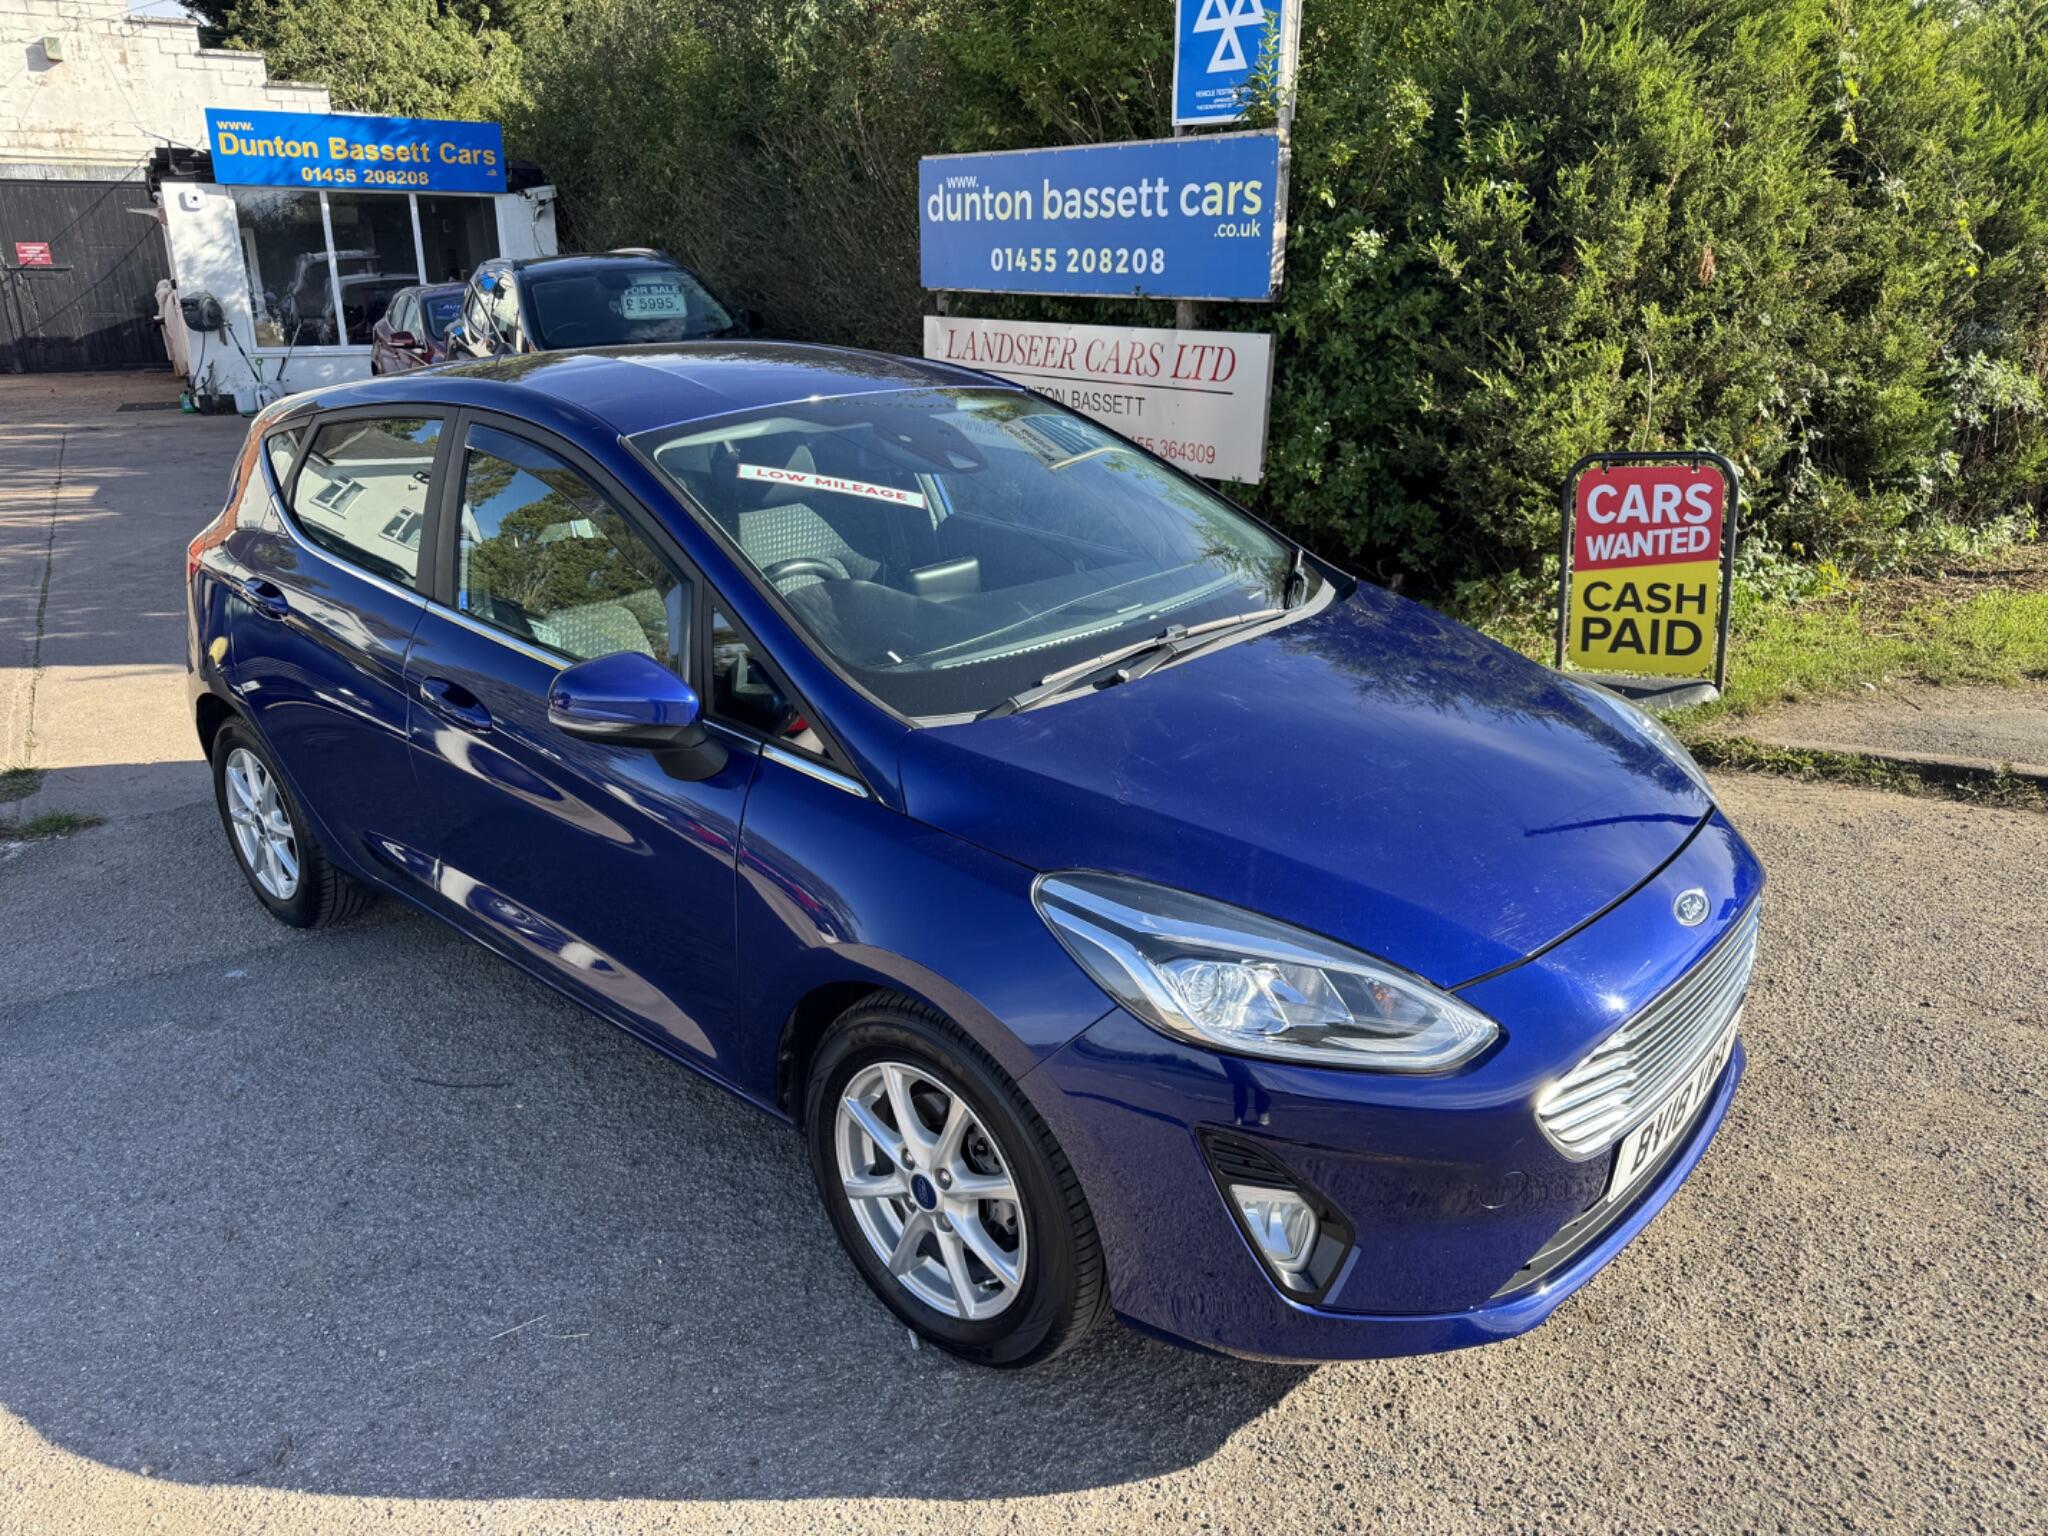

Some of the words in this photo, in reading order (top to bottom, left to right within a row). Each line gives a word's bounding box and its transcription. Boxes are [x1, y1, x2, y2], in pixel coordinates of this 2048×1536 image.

[216, 120, 254, 131] www.
[218, 132, 319, 158] Dunton
[328, 136, 431, 163] Bassett
[440, 142, 497, 165] Cars
[301, 167, 357, 183] 01455
[363, 169, 430, 185] 208208
[946, 176, 979, 189] www.
[927, 184, 1033, 222] dunton
[1042, 178, 1169, 220] bassett
[1179, 179, 1262, 216] cars
[1213, 219, 1261, 238] .co.uk
[990, 247, 1057, 272] 01455
[1066, 248, 1165, 274] 208208
[946, 329, 1077, 370] LANDSEER
[1085, 339, 1164, 377] CARS
[1170, 344, 1236, 383] LTD
[1071, 389, 1145, 417] BASSETT
[1159, 438, 1216, 465] 364309
[757, 469, 806, 483] LOW
[815, 477, 907, 501] MILEAGE
[1587, 483, 1713, 524] CARS
[1586, 525, 1711, 561] WANTED
[1583, 581, 1707, 615] CASH
[1581, 617, 1703, 656] PAID
